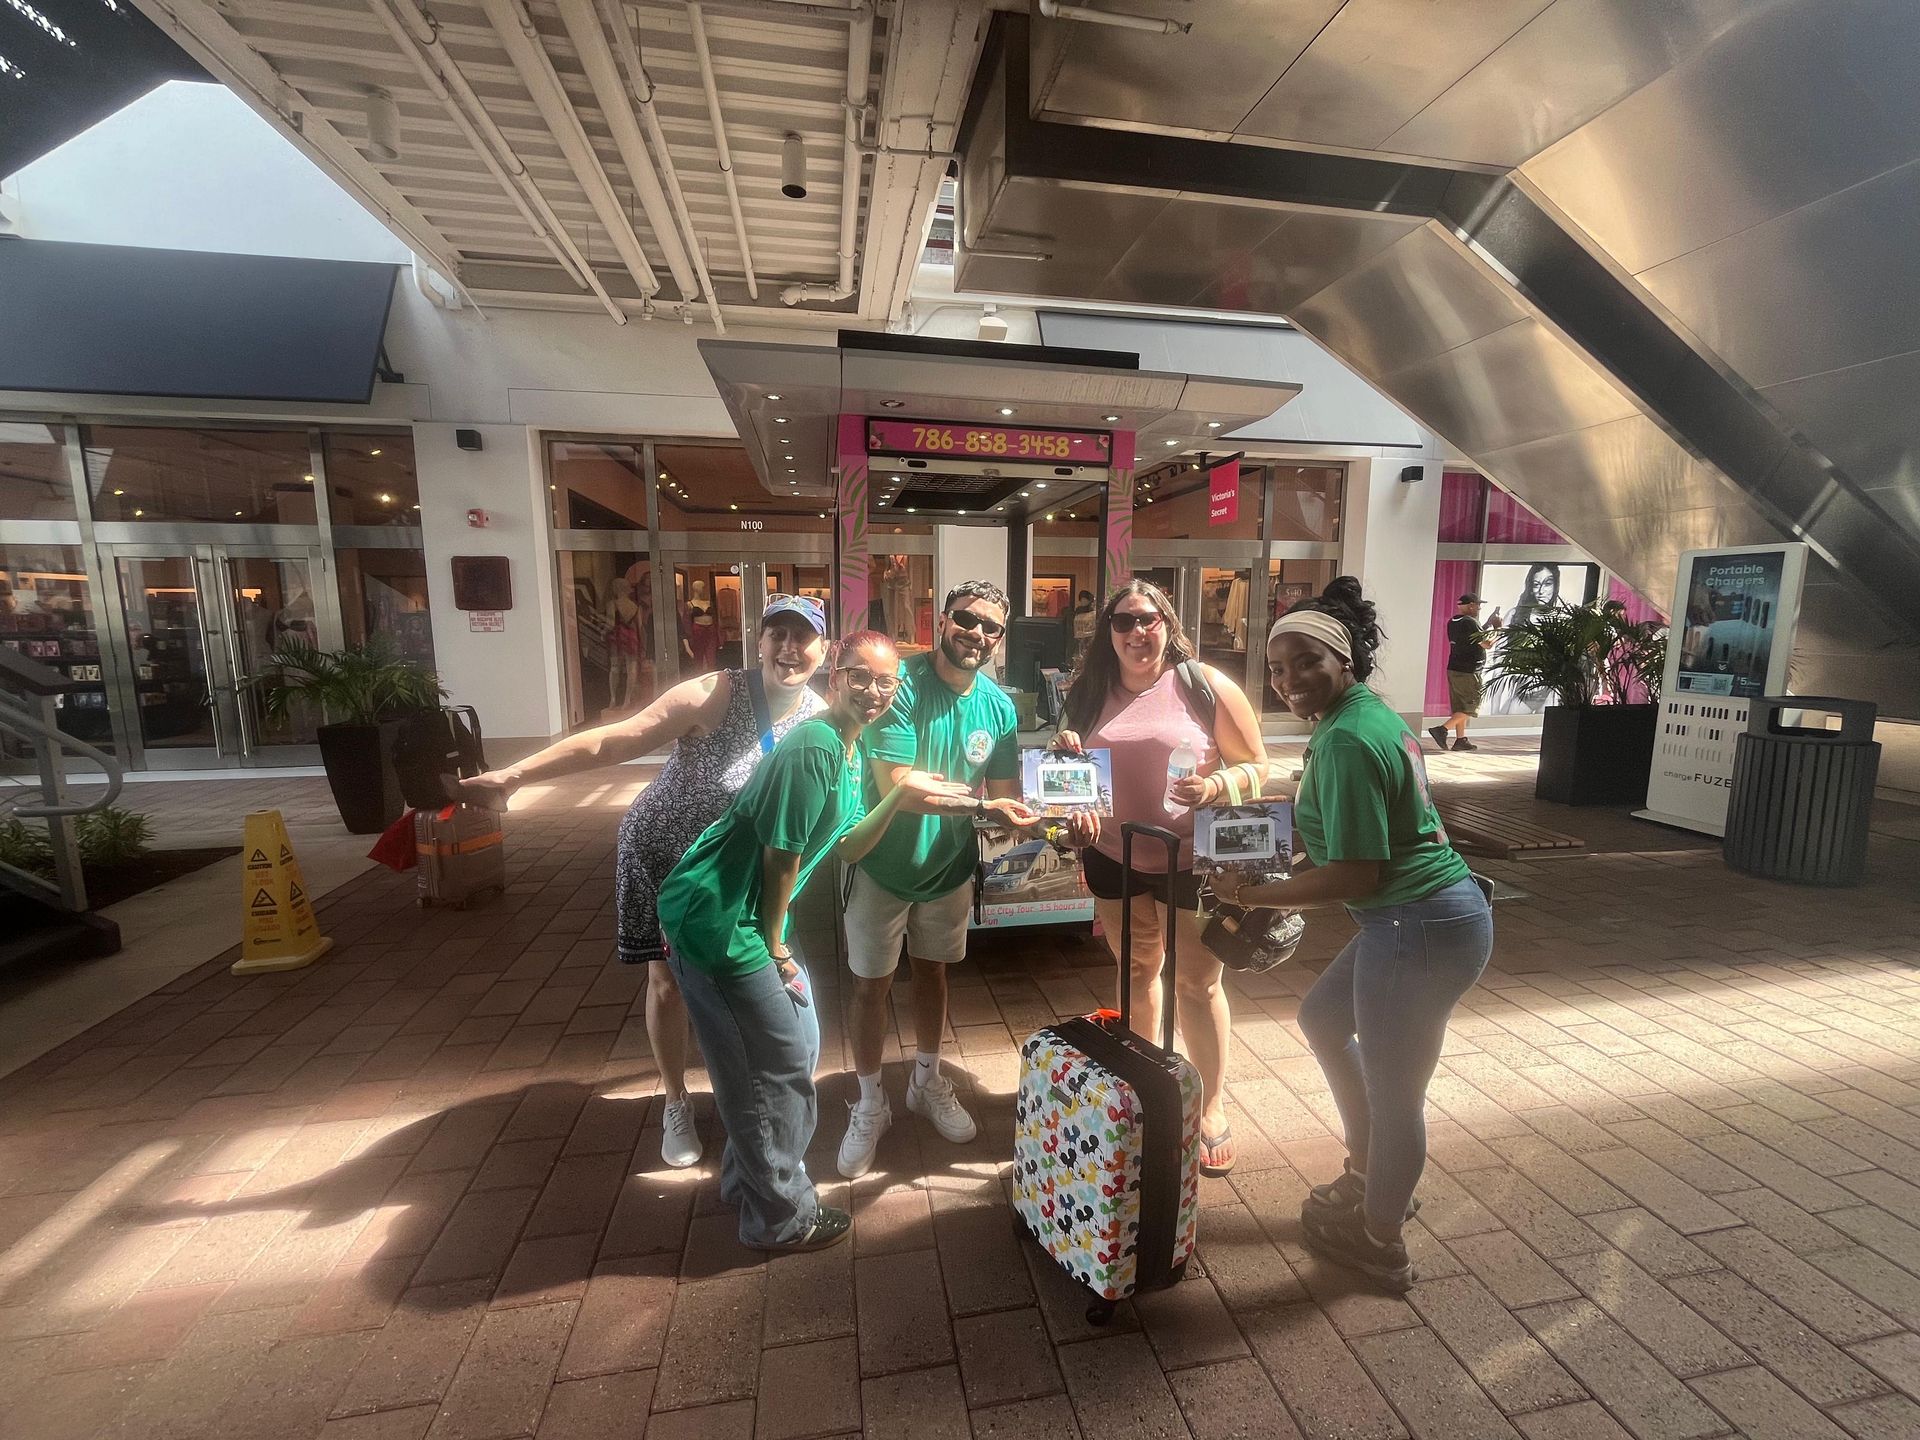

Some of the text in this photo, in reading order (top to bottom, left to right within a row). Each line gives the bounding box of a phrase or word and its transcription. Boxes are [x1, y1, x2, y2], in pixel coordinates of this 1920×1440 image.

[912, 427, 1070, 458] 786-858-3458
[1211, 489, 1235, 503] Victoria's
[1211, 506, 1228, 518] Secret
[740, 520, 763, 530] N100
[1709, 564, 1765, 576] Portable
[1705, 576, 1765, 588] Chargers
[1663, 771, 1733, 788] charge FUZE
[997, 906, 1014, 917] City
